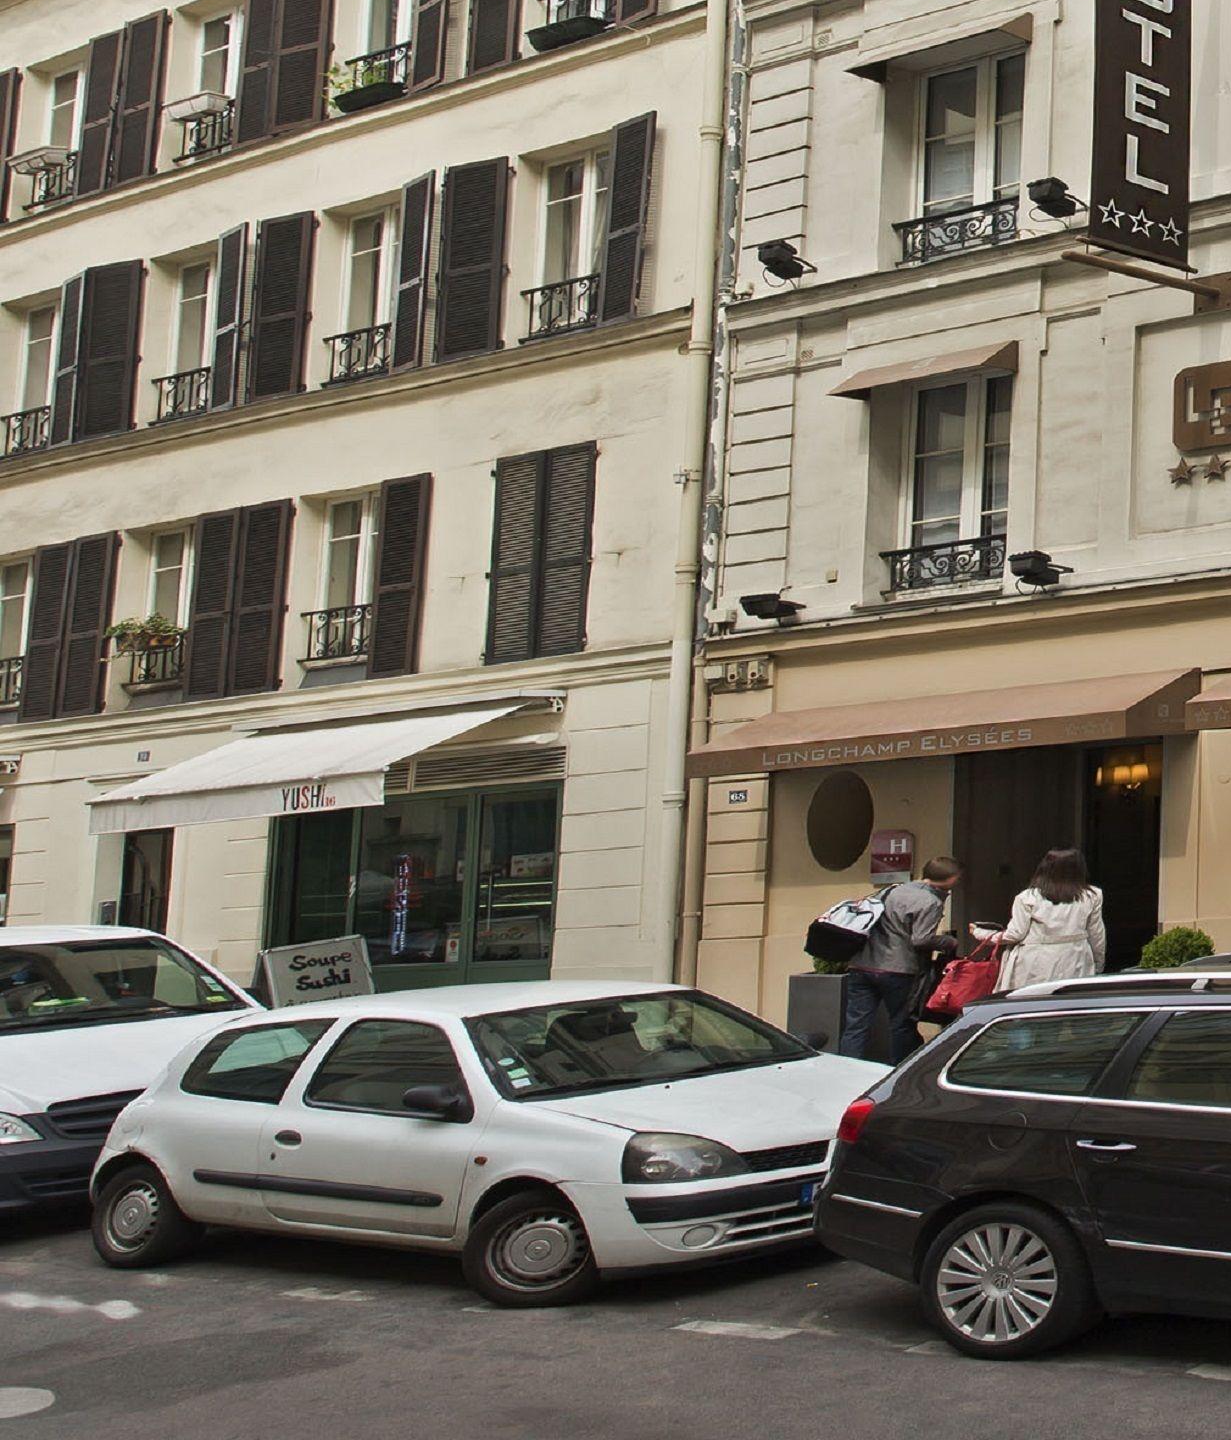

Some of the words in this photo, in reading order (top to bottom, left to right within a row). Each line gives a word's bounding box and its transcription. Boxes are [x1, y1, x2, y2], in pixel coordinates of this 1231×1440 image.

[762, 740, 912, 767] LONGCHAMP
[890, 838, 907, 855] H
[289, 951, 352, 971] Soupe
[296, 968, 351, 991] Sushi
